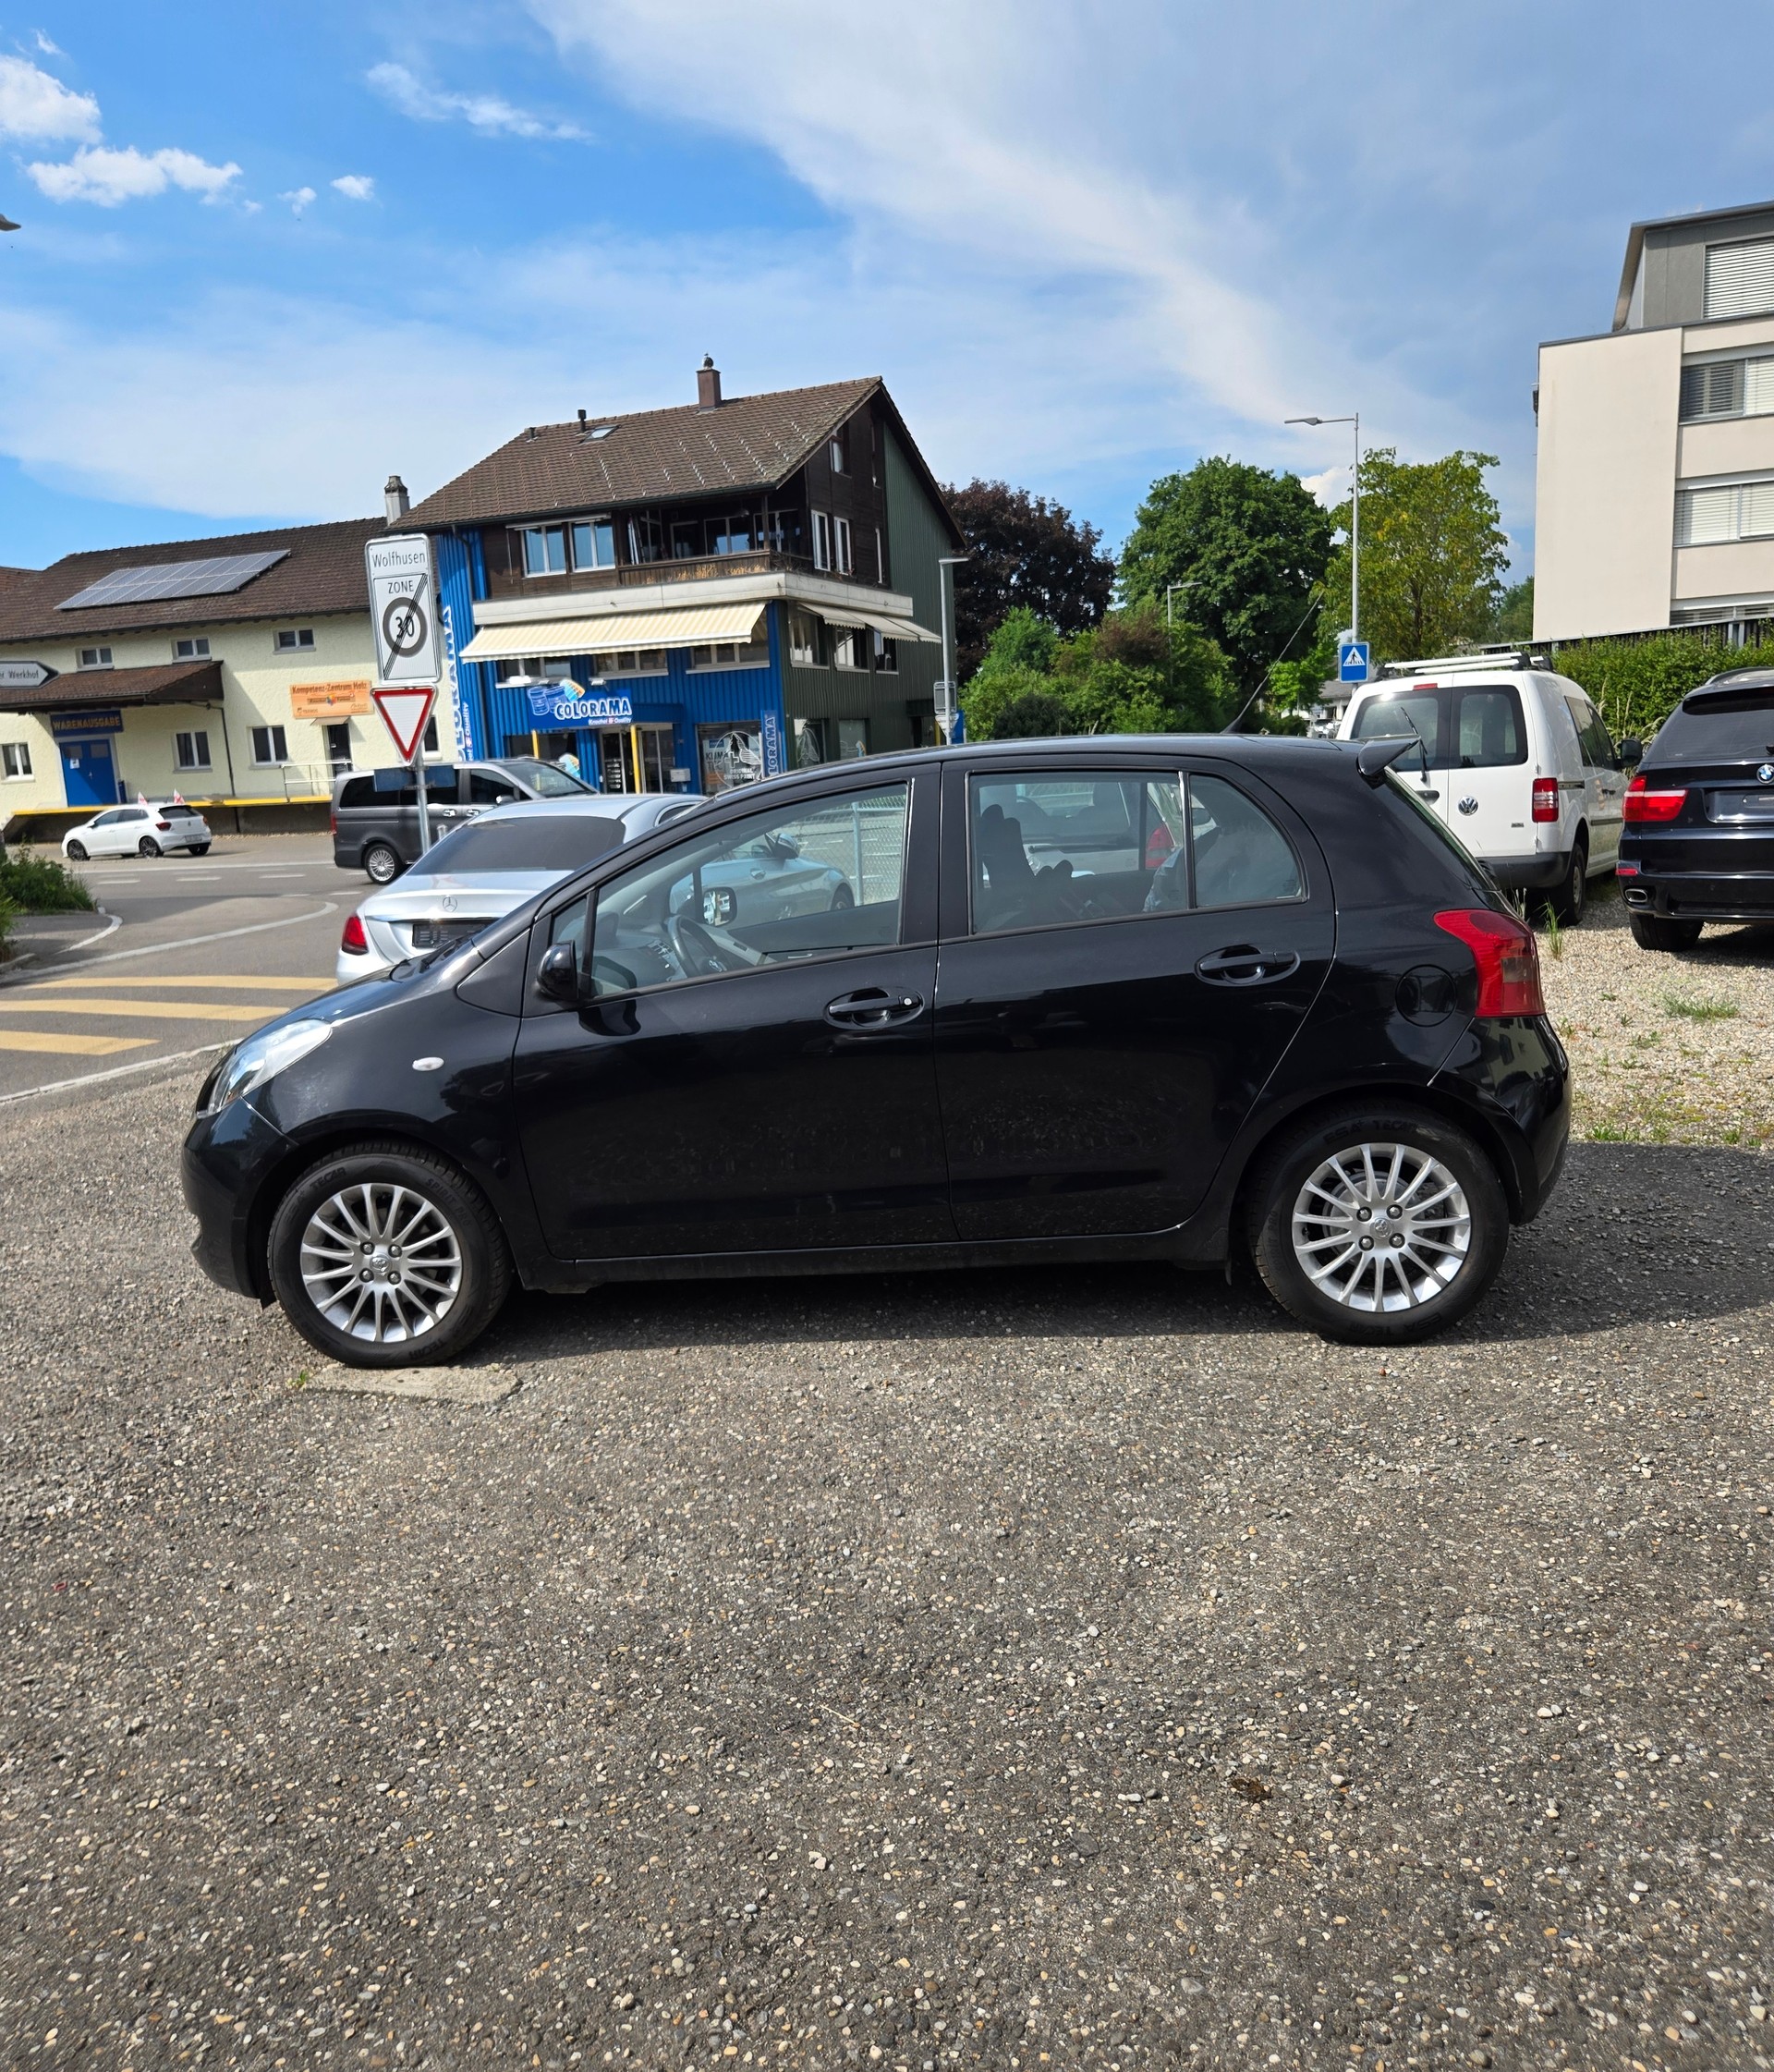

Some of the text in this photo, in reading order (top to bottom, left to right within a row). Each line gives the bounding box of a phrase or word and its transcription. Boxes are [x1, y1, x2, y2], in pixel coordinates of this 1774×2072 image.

[372, 551, 426, 567] Wolfhusen
[388, 580, 414, 594] ZONE
[395, 616, 415, 640] 30
[8, 669, 39, 679] Werkhof
[353, 681, 367, 690] Holz
[444, 605, 466, 762] OLORAMA
[554, 698, 632, 721] COLORAMA
[53, 716, 119, 730] WARENAUSGABE
[765, 716, 780, 777] LORAMA
